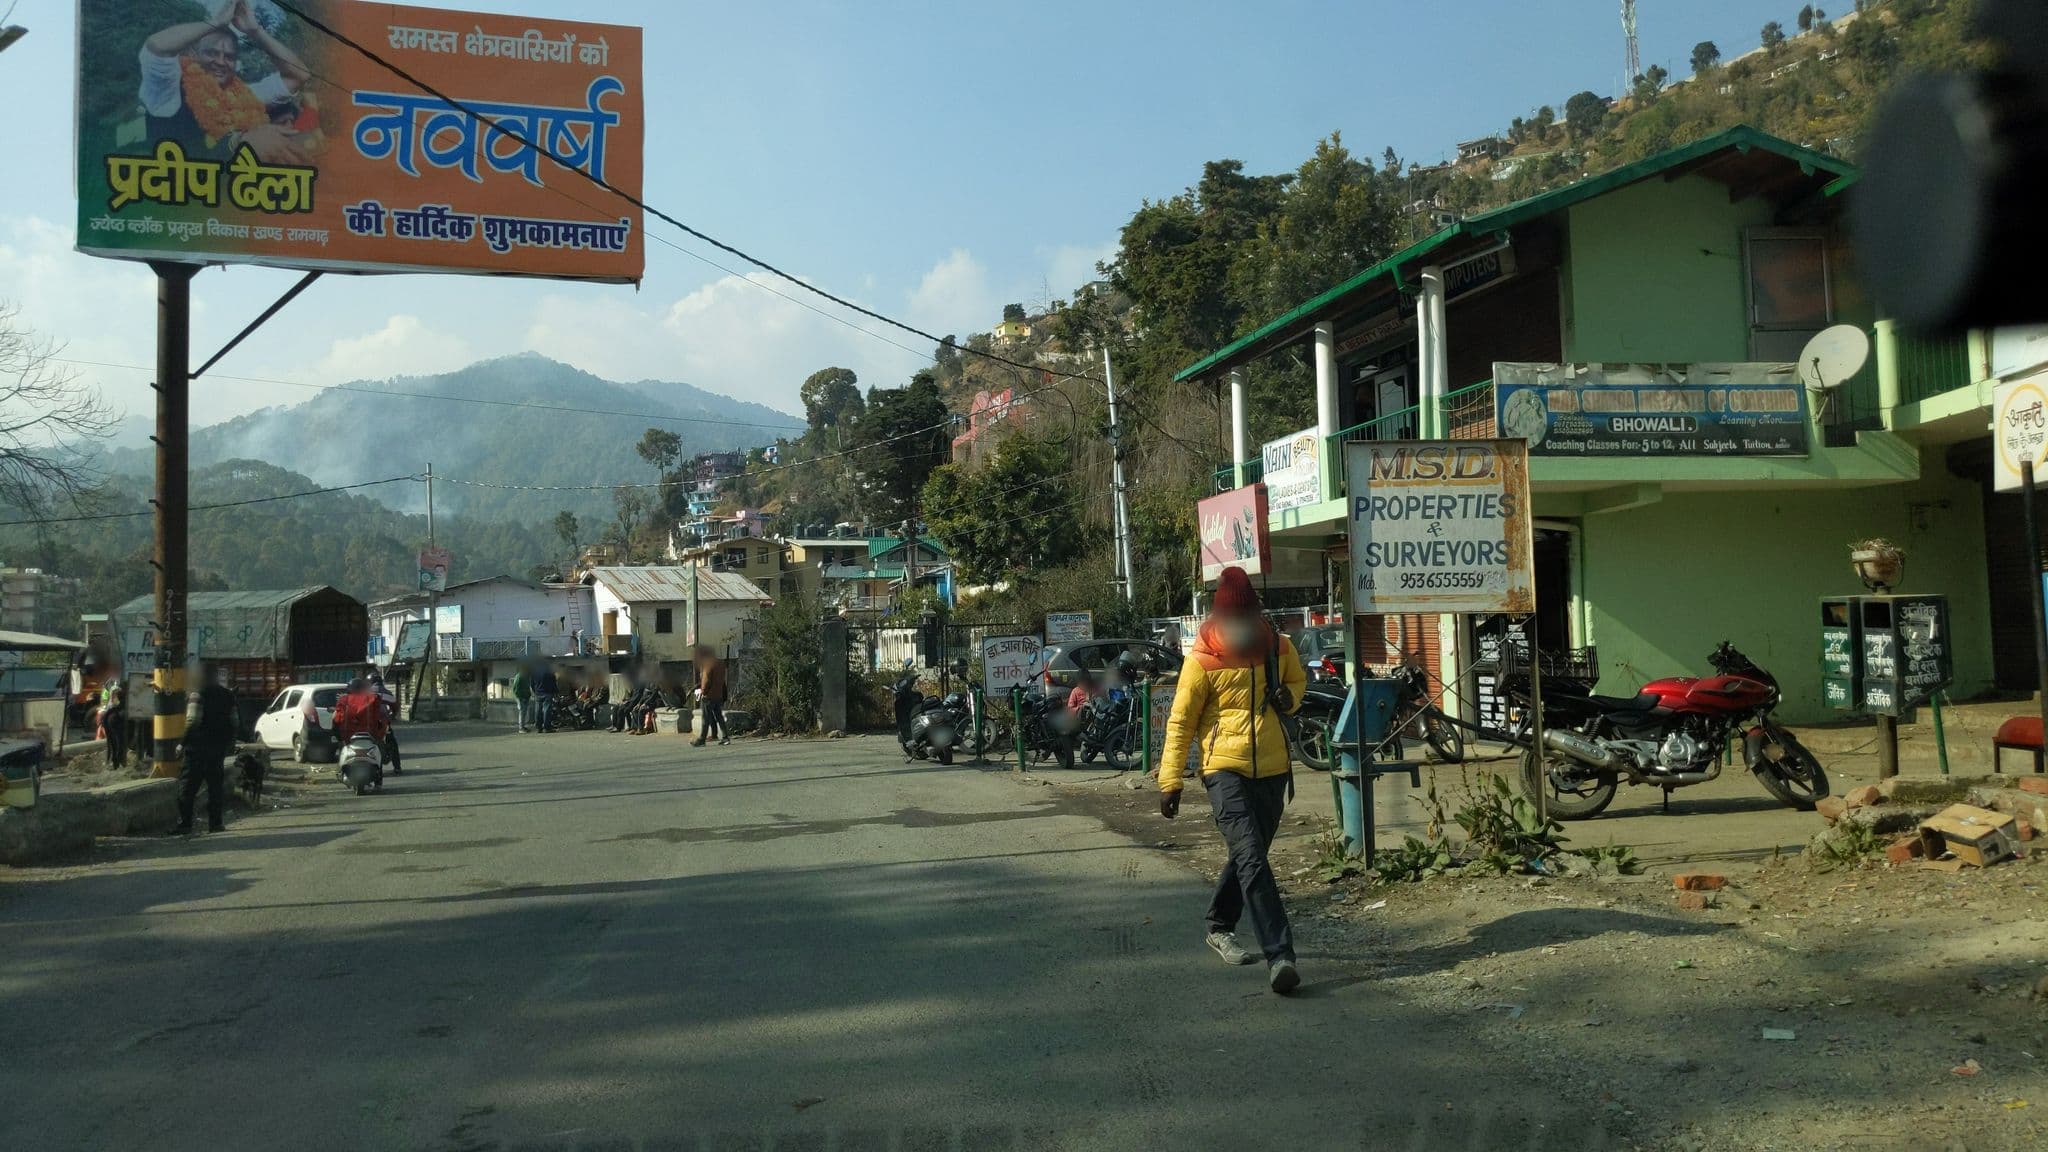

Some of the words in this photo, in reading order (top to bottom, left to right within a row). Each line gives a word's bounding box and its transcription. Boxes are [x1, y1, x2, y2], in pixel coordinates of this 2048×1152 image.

[388, 25, 459, 54] समस्त
[464, 25, 577, 63] क्षेत्रवासियों
[578, 37, 609, 66] को
[352, 75, 625, 190] नववर्ष
[107, 142, 221, 209] प्रदीप
[229, 144, 316, 211] ढैला
[89, 215, 126, 232] ज्येष्ठ
[127, 216, 163, 234] ब्लॉक
[167, 221, 203, 241] प्रमुख
[207, 218, 249, 238] विकास
[253, 225, 283, 241] खण्ड
[288, 229, 329, 246] रामगढ़
[344, 201, 386, 236] की
[391, 205, 476, 240] हार्दिक
[481, 215, 631, 252] शुभकामनाएं
[1720, 414, 1757, 427] Learning
[1264, 441, 1292, 475] NAINI
[1293, 437, 1316, 458] BEAUTY
[1545, 439, 1585, 452] Coaching
[1587, 439, 1620, 450] Classes
[1642, 440, 1650, 452] 5
[1650, 440, 1660, 450] to
[1679, 439, 1696, 450] All
[1703, 439, 1738, 453] Subjects
[1367, 446, 1496, 481] M.S.D.
[1355, 493, 1517, 521] PROPERTIES
[1427, 521, 1444, 537] &
[1365, 540, 1513, 568] SURVEYORS
[1358, 574, 1378, 591] Mob.
